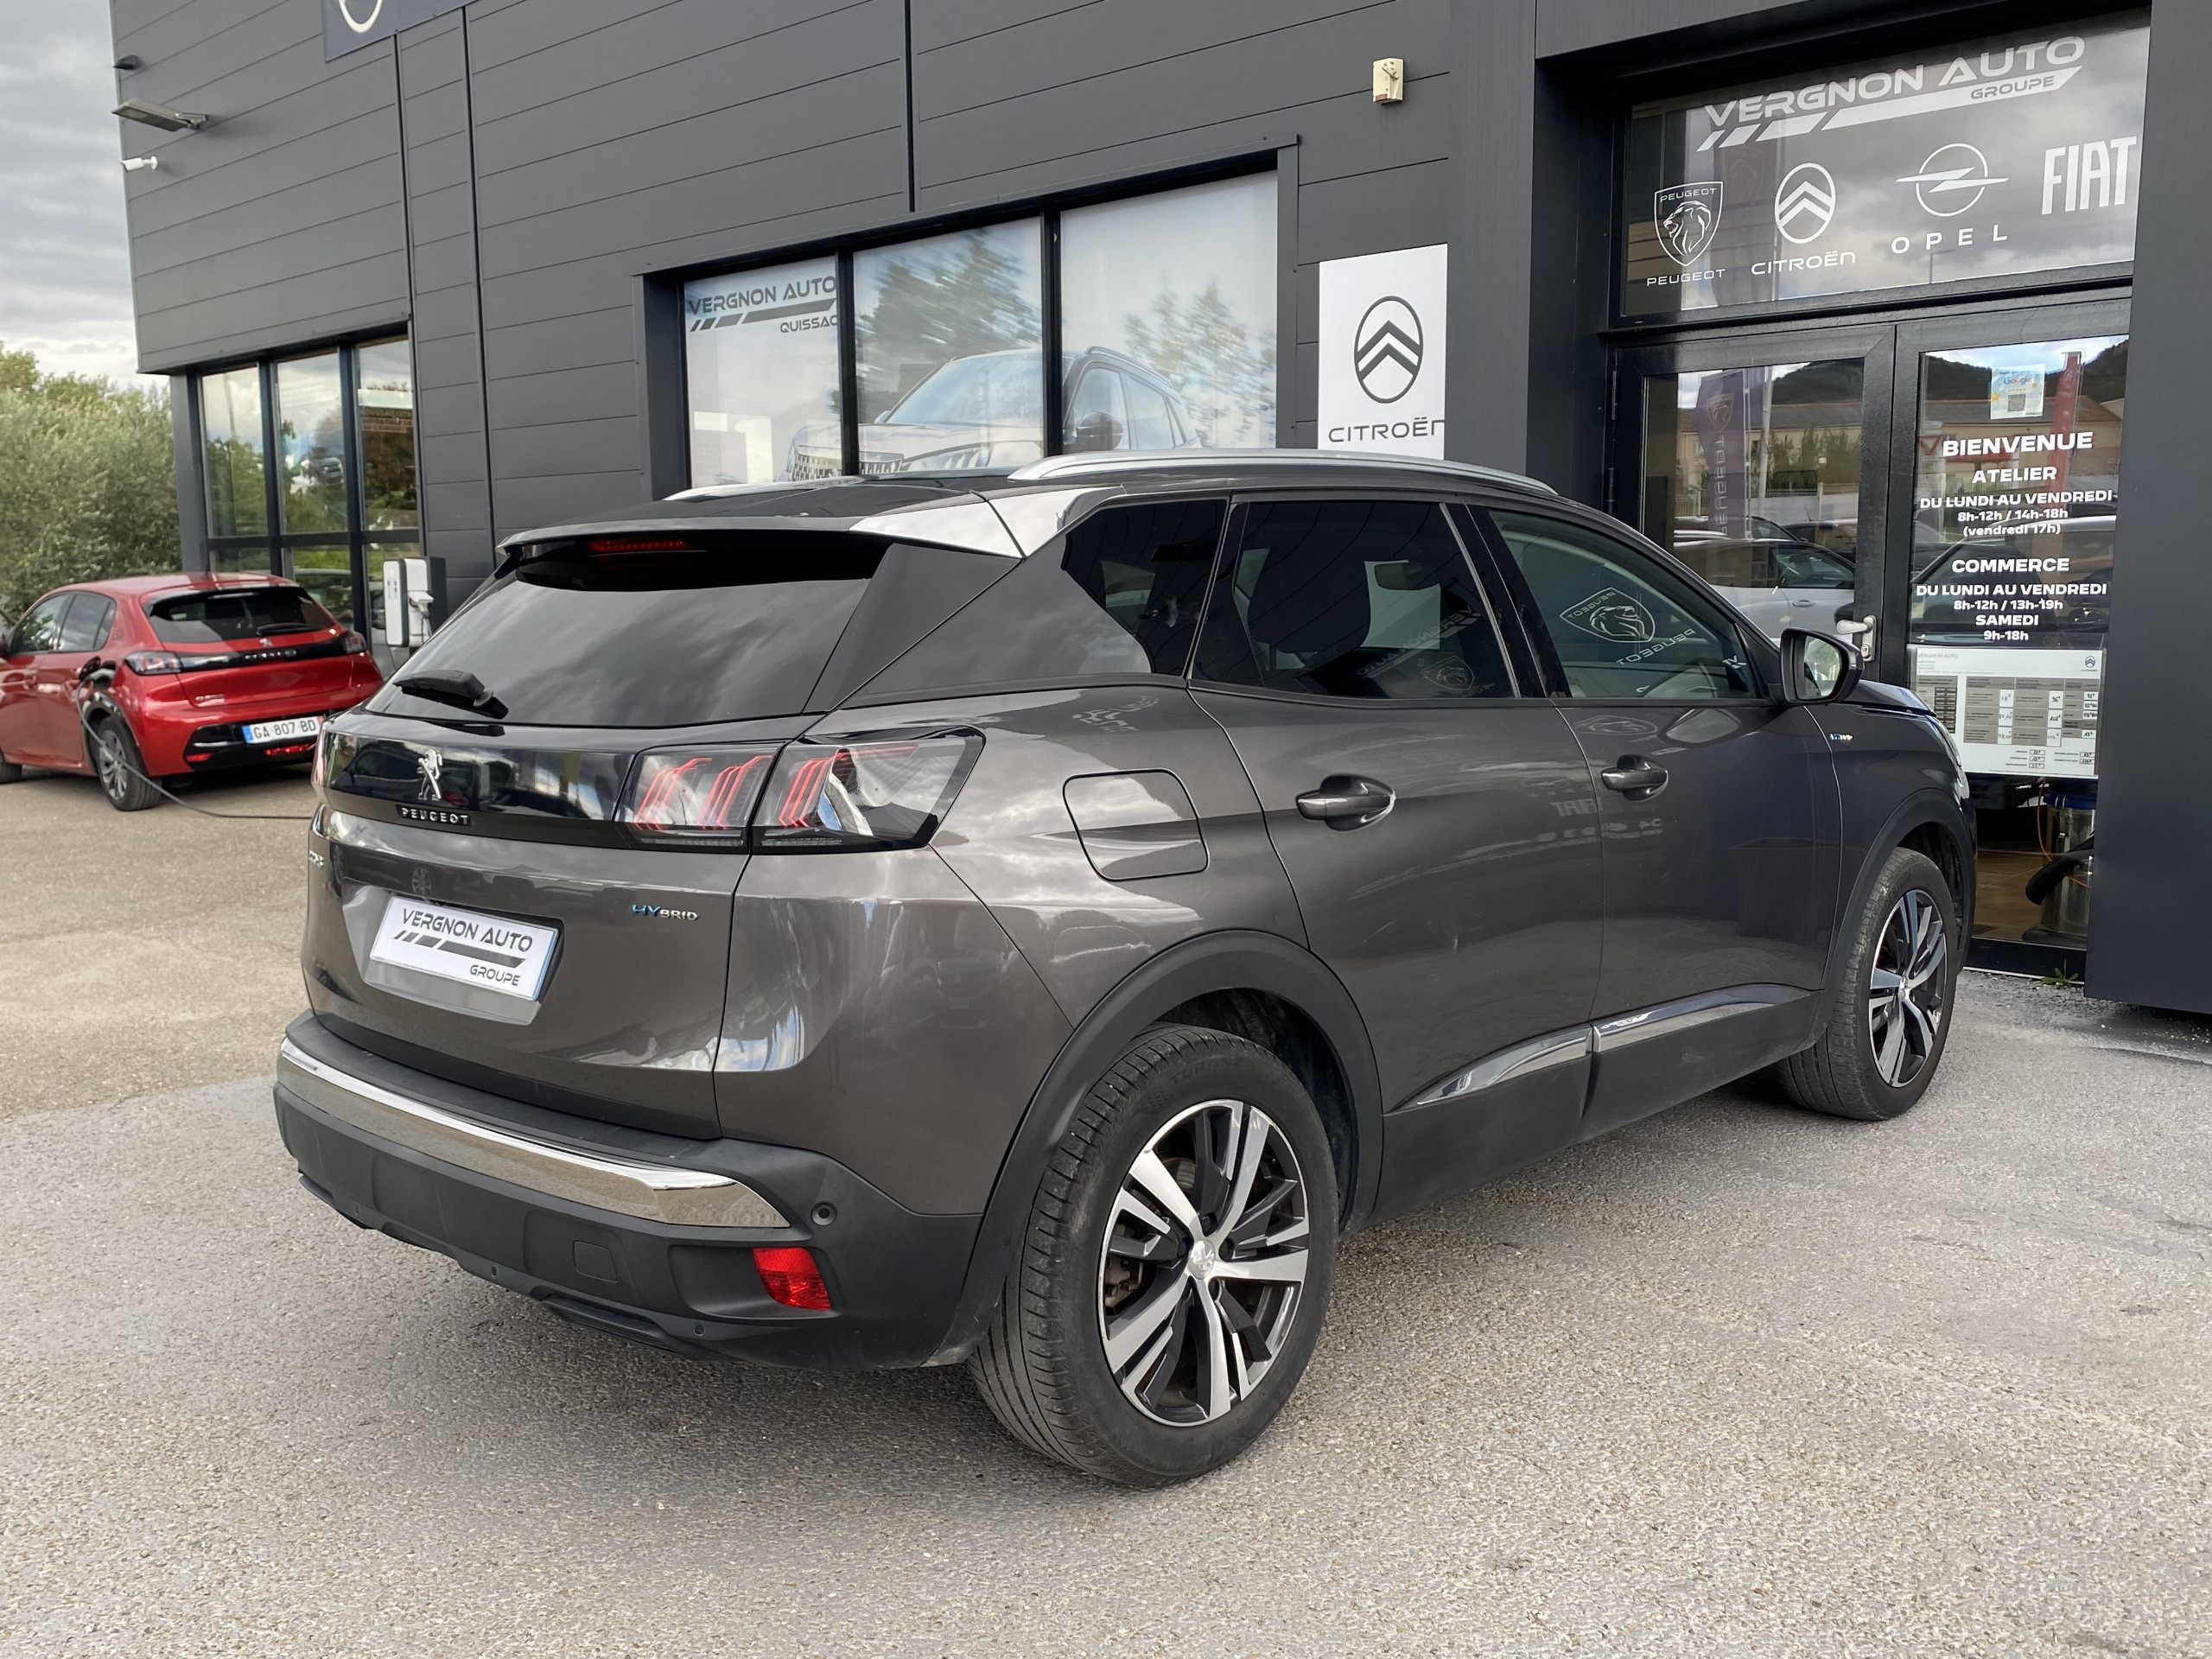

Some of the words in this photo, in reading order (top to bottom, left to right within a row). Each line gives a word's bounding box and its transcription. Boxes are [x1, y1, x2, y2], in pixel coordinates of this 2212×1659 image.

[1705, 65, 1923, 126] VERGNON
[1939, 36, 2086, 86] AUTO
[1970, 75, 2056, 99] GROUPE
[2041, 136, 2137, 215] FIAT
[1660, 188, 1717, 203] PEUGEOT
[1891, 224, 2007, 254] OPEL
[1751, 251, 1856, 276] CITROËN
[1646, 269, 1726, 286] PEUGEOT
[688, 286, 777, 315] VERGNON
[783, 276, 836, 301] AUTO
[780, 315, 837, 334] QUISSAC
[2004, 375, 2031, 385] Google
[1942, 432, 2094, 456] BIENVENUE
[1972, 467, 2057, 483] ATELIER
[1920, 498, 1942, 509] DU
[1946, 495, 1993, 507] LUNDI
[1997, 493, 2021, 505] AU
[2024, 490, 2113, 505] VENDREDI
[1957, 511, 2002, 522] 8h-12h
[2014, 508, 2069, 519] 14h-18h
[1963, 524, 2029, 537] (vendredi
[2033, 524, 2061, 535] 17h)
[1952, 558, 2070, 573] COMMERCE
[1916, 584, 1939, 595] DU
[1942, 584, 1989, 595] LUNDI
[1993, 584, 2017, 595] AU
[2020, 583, 2107, 595] VENDREDI
[1954, 600, 1998, 611] 8h-12h
[2011, 598, 2063, 610] 13h-19h
[1975, 614, 2039, 626] SAMEDI
[1983, 630, 2029, 641] 9h-18h
[254, 726, 270, 739] GA
[274, 721, 296, 735] 807
[300, 719, 316, 733] BD
[401, 807, 468, 825] PEUGEOT
[632, 904, 699, 921] HYBRID
[403, 907, 480, 940] VERGNON
[480, 927, 533, 952] AUTO
[470, 963, 521, 986] GROUPE
